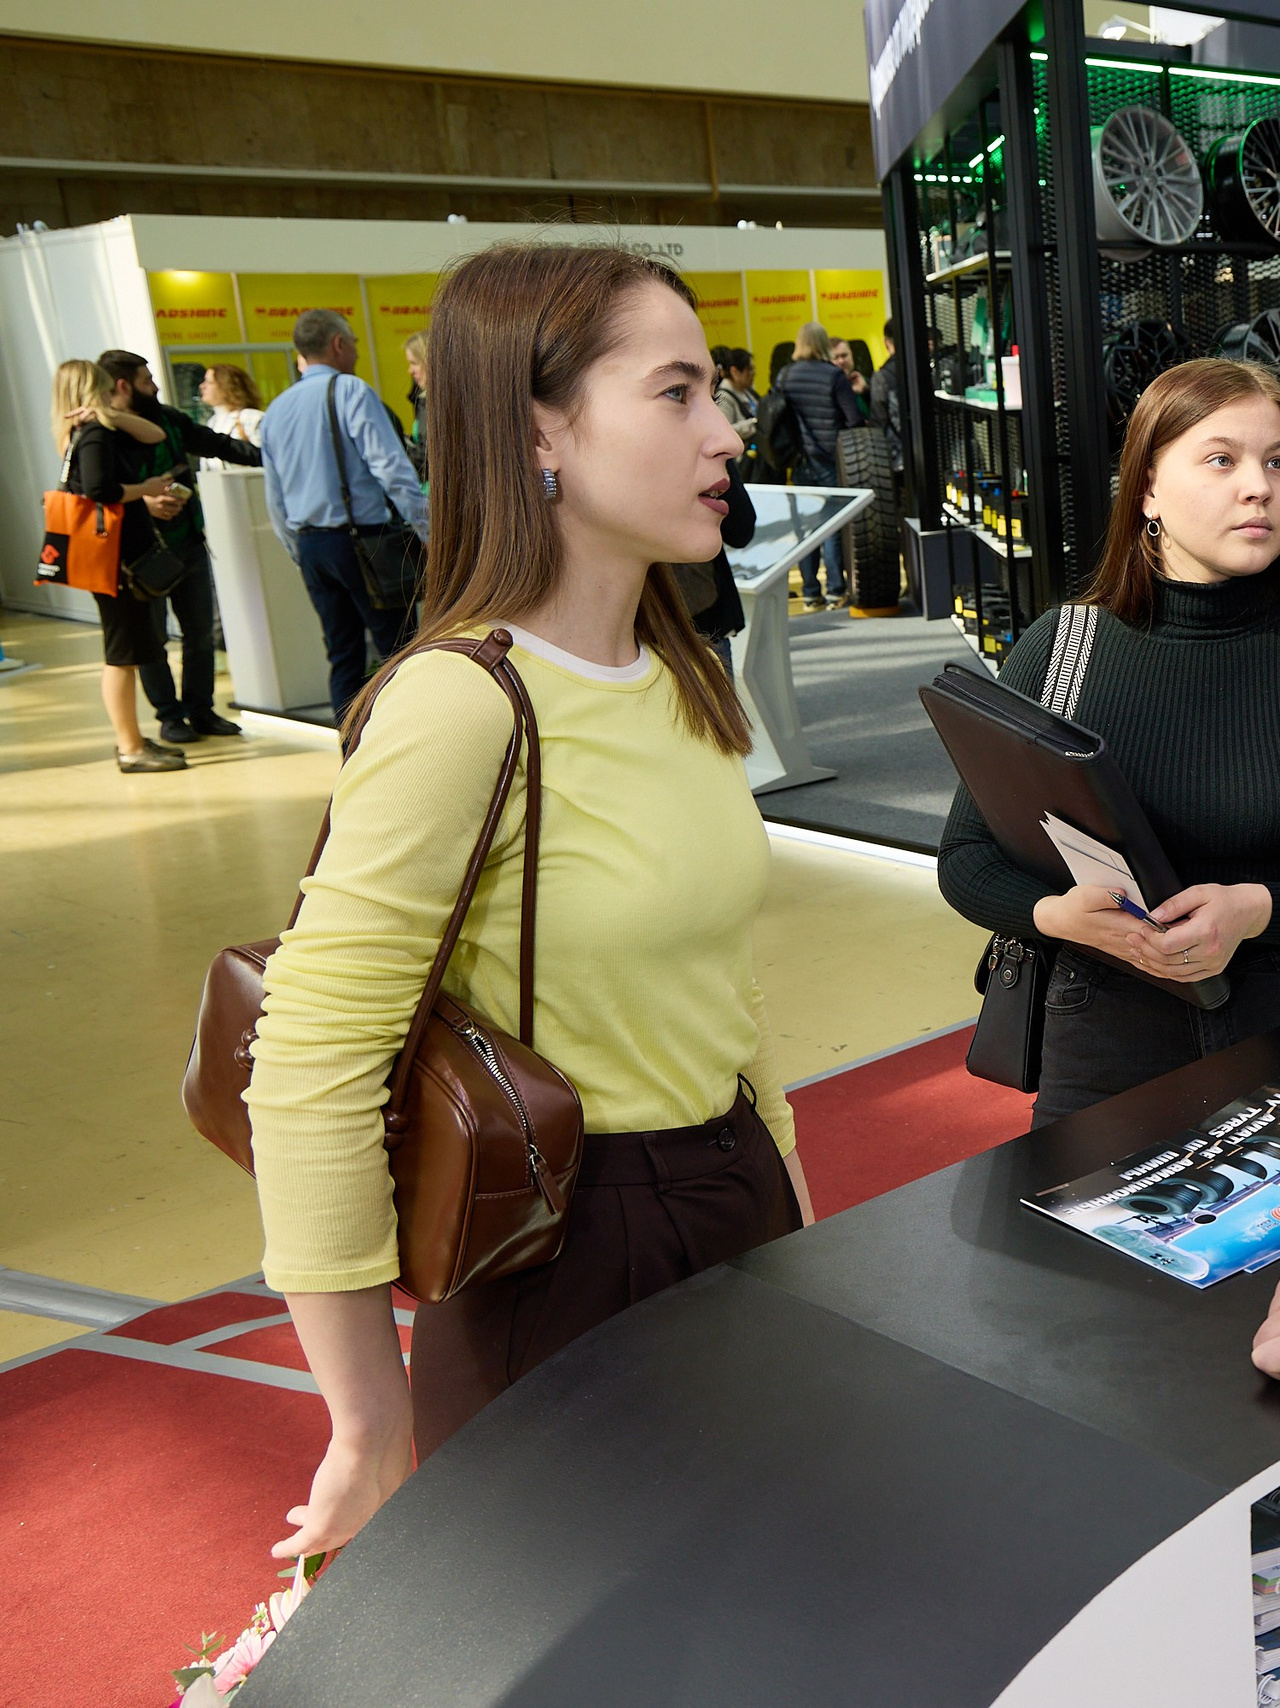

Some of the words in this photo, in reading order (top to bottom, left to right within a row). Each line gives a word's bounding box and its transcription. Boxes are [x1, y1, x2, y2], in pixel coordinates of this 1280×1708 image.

[1208, 1106, 1263, 1139] TYRES
[1118, 1150, 1180, 1181] ШИНЫ
[1061, 1157, 1194, 1216] АВИАЦИОННЫЕ
